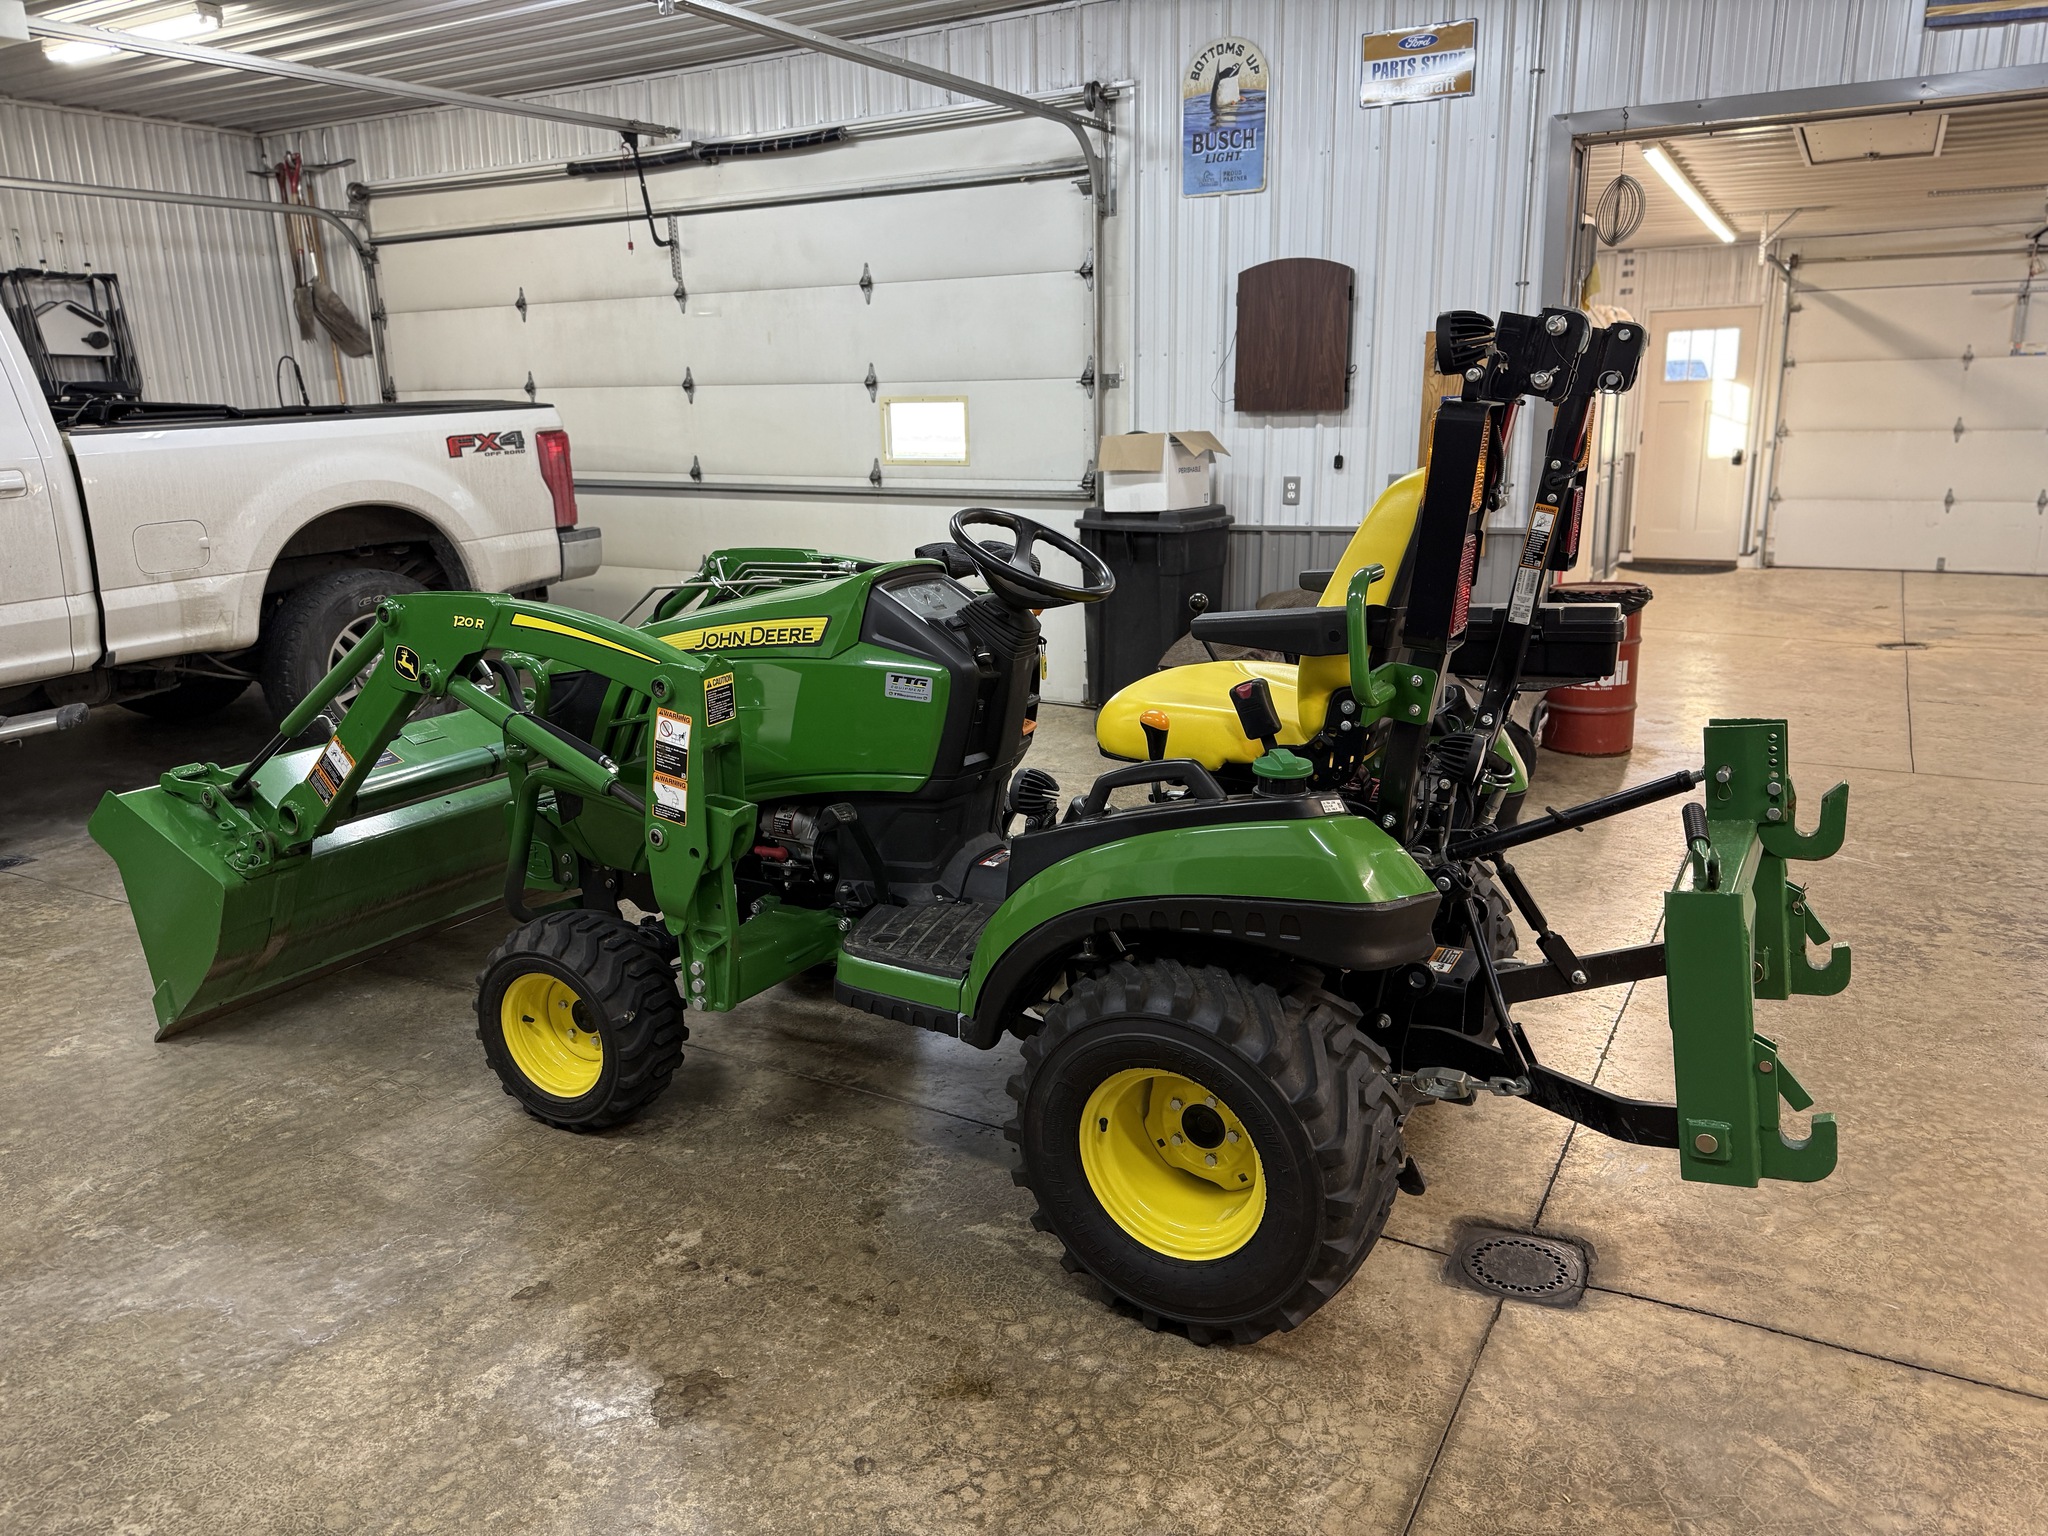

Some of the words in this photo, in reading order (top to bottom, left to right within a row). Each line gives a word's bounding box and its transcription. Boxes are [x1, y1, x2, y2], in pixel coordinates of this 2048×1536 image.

[1405, 34, 1431, 48] Ford
[1190, 42, 1245, 81] BOTTOMS
[1245, 53, 1260, 75] UP
[1372, 56, 1417, 80] PARTS
[1191, 128, 1257, 156] BUSCH
[1222, 174, 1248, 183] PARTNER
[446, 430, 525, 458] FX4
[694, 631, 746, 650] JOHN
[750, 626, 815, 644] DEERE
[712, 674, 733, 687] CAUTION
[890, 674, 929, 688] TTG
[890, 685, 925, 693] EQUIPMENT
[664, 709, 691, 724] WARNING
[660, 775, 686, 789] WARNING
